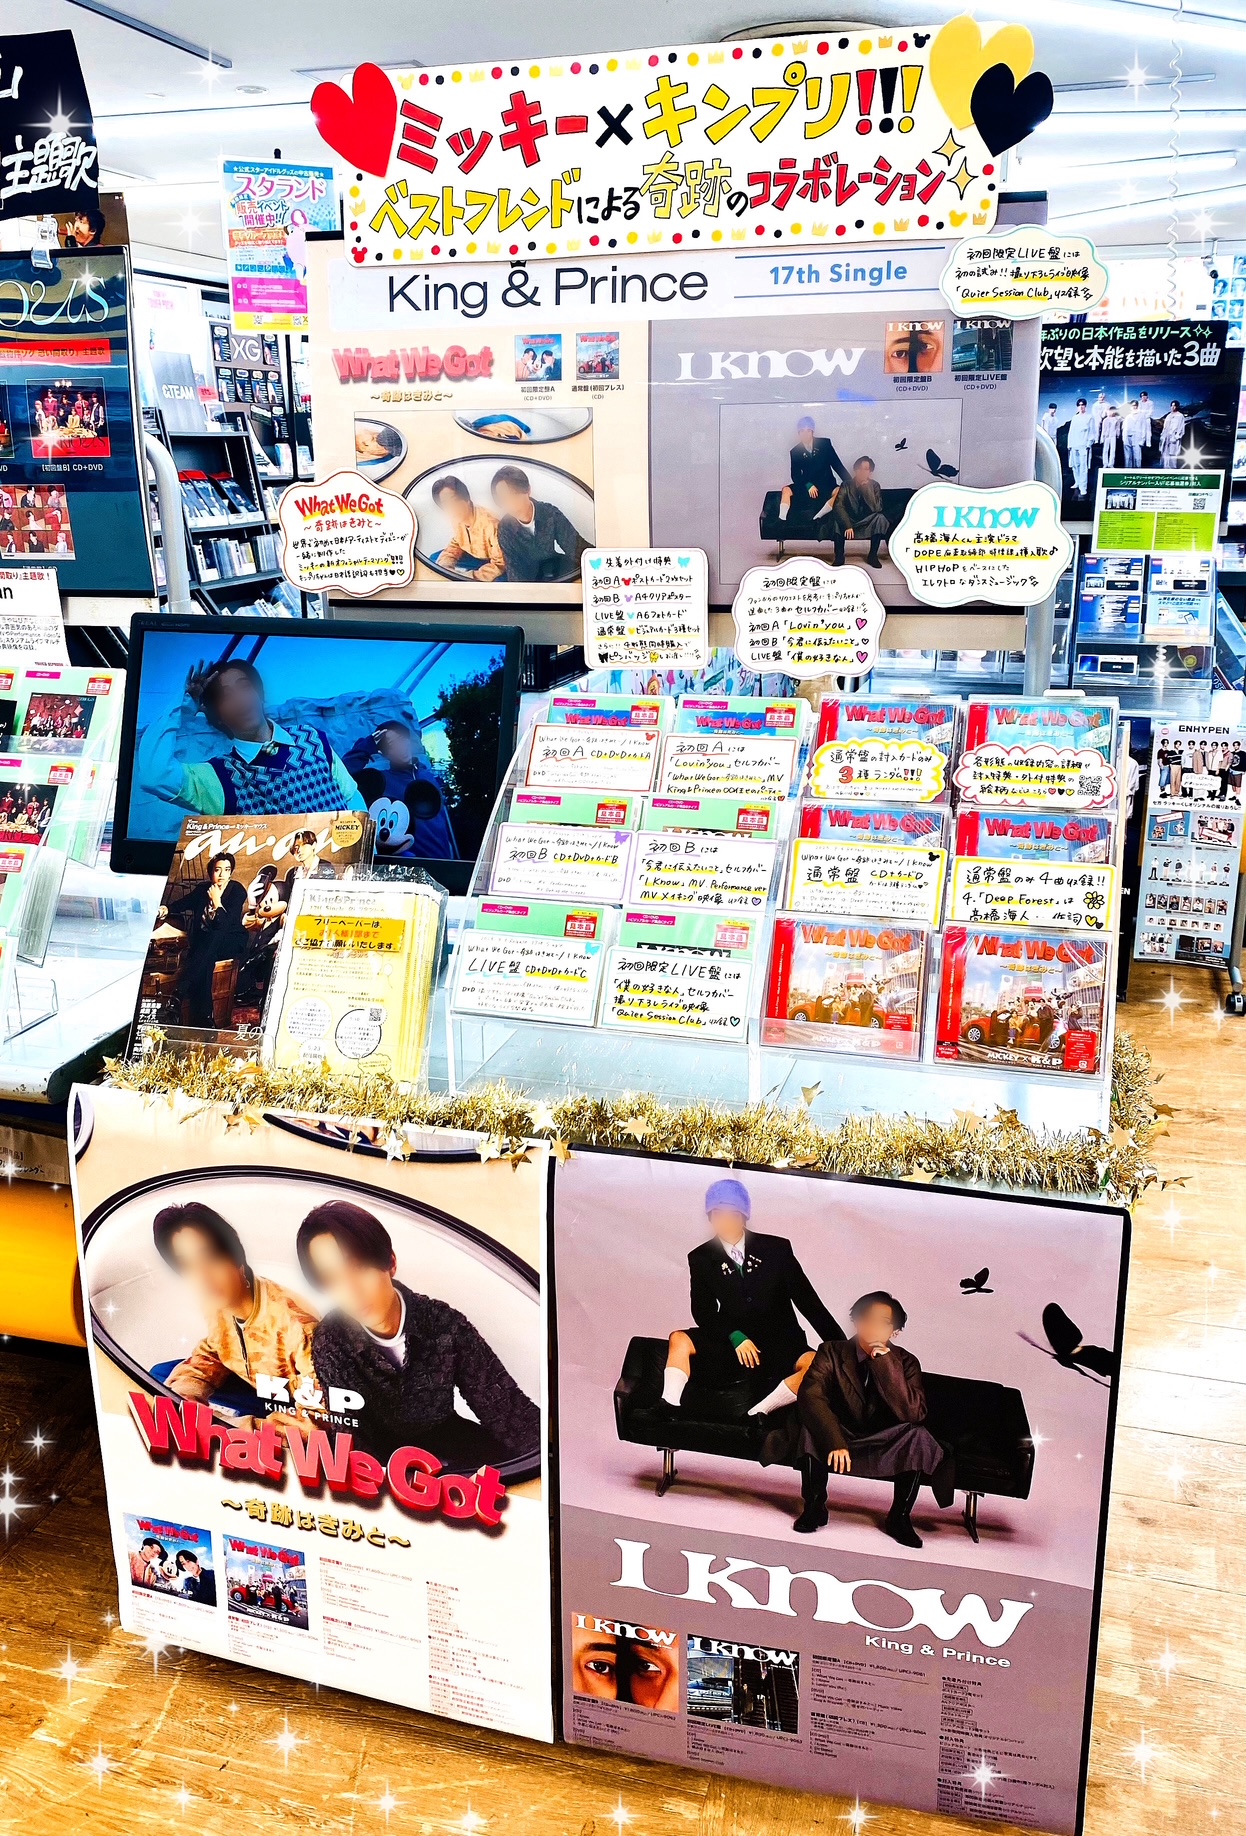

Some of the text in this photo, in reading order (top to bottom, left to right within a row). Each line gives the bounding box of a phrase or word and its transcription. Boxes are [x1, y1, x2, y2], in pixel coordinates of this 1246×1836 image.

[1, 132, 98, 198] 主題歌
[236, 175, 325, 201] スタランド
[369, 150, 946, 240] ベストフレンドによる奇跡のコラボレーション
[769, 260, 908, 286] 17th Single
[388, 265, 708, 319] King & Prince
[231, 339, 261, 361] XG
[332, 345, 495, 383] What We Got
[676, 352, 696, 381] I
[72, 464, 104, 472] CD+DVD
[294, 493, 384, 517] What We Got
[932, 506, 948, 528] I
[751, 650, 782, 661] LIVE盤
[845, 705, 946, 724] What We Got
[1179, 725, 1230, 734] ENHYPEN
[542, 746, 584, 758] 初回A
[187, 823, 202, 831] King
[828, 810, 934, 834] What We Got
[985, 817, 1099, 842] What We Got
[509, 847, 548, 860] 初回B
[807, 866, 860, 884] 通常盤
[801, 924, 914, 952] What We Got
[468, 958, 521, 973] LIVE盤
[617, 957, 742, 981] 初回限定LIVE盤には
[256, 1373, 366, 1414] K&P
[264, 1402, 360, 1428] KING & PRINCE
[128, 1391, 508, 1529] What We Got
[221, 1498, 412, 1548] ～奇跡はきみと～
[865, 1635, 1012, 1668] King & Prince
